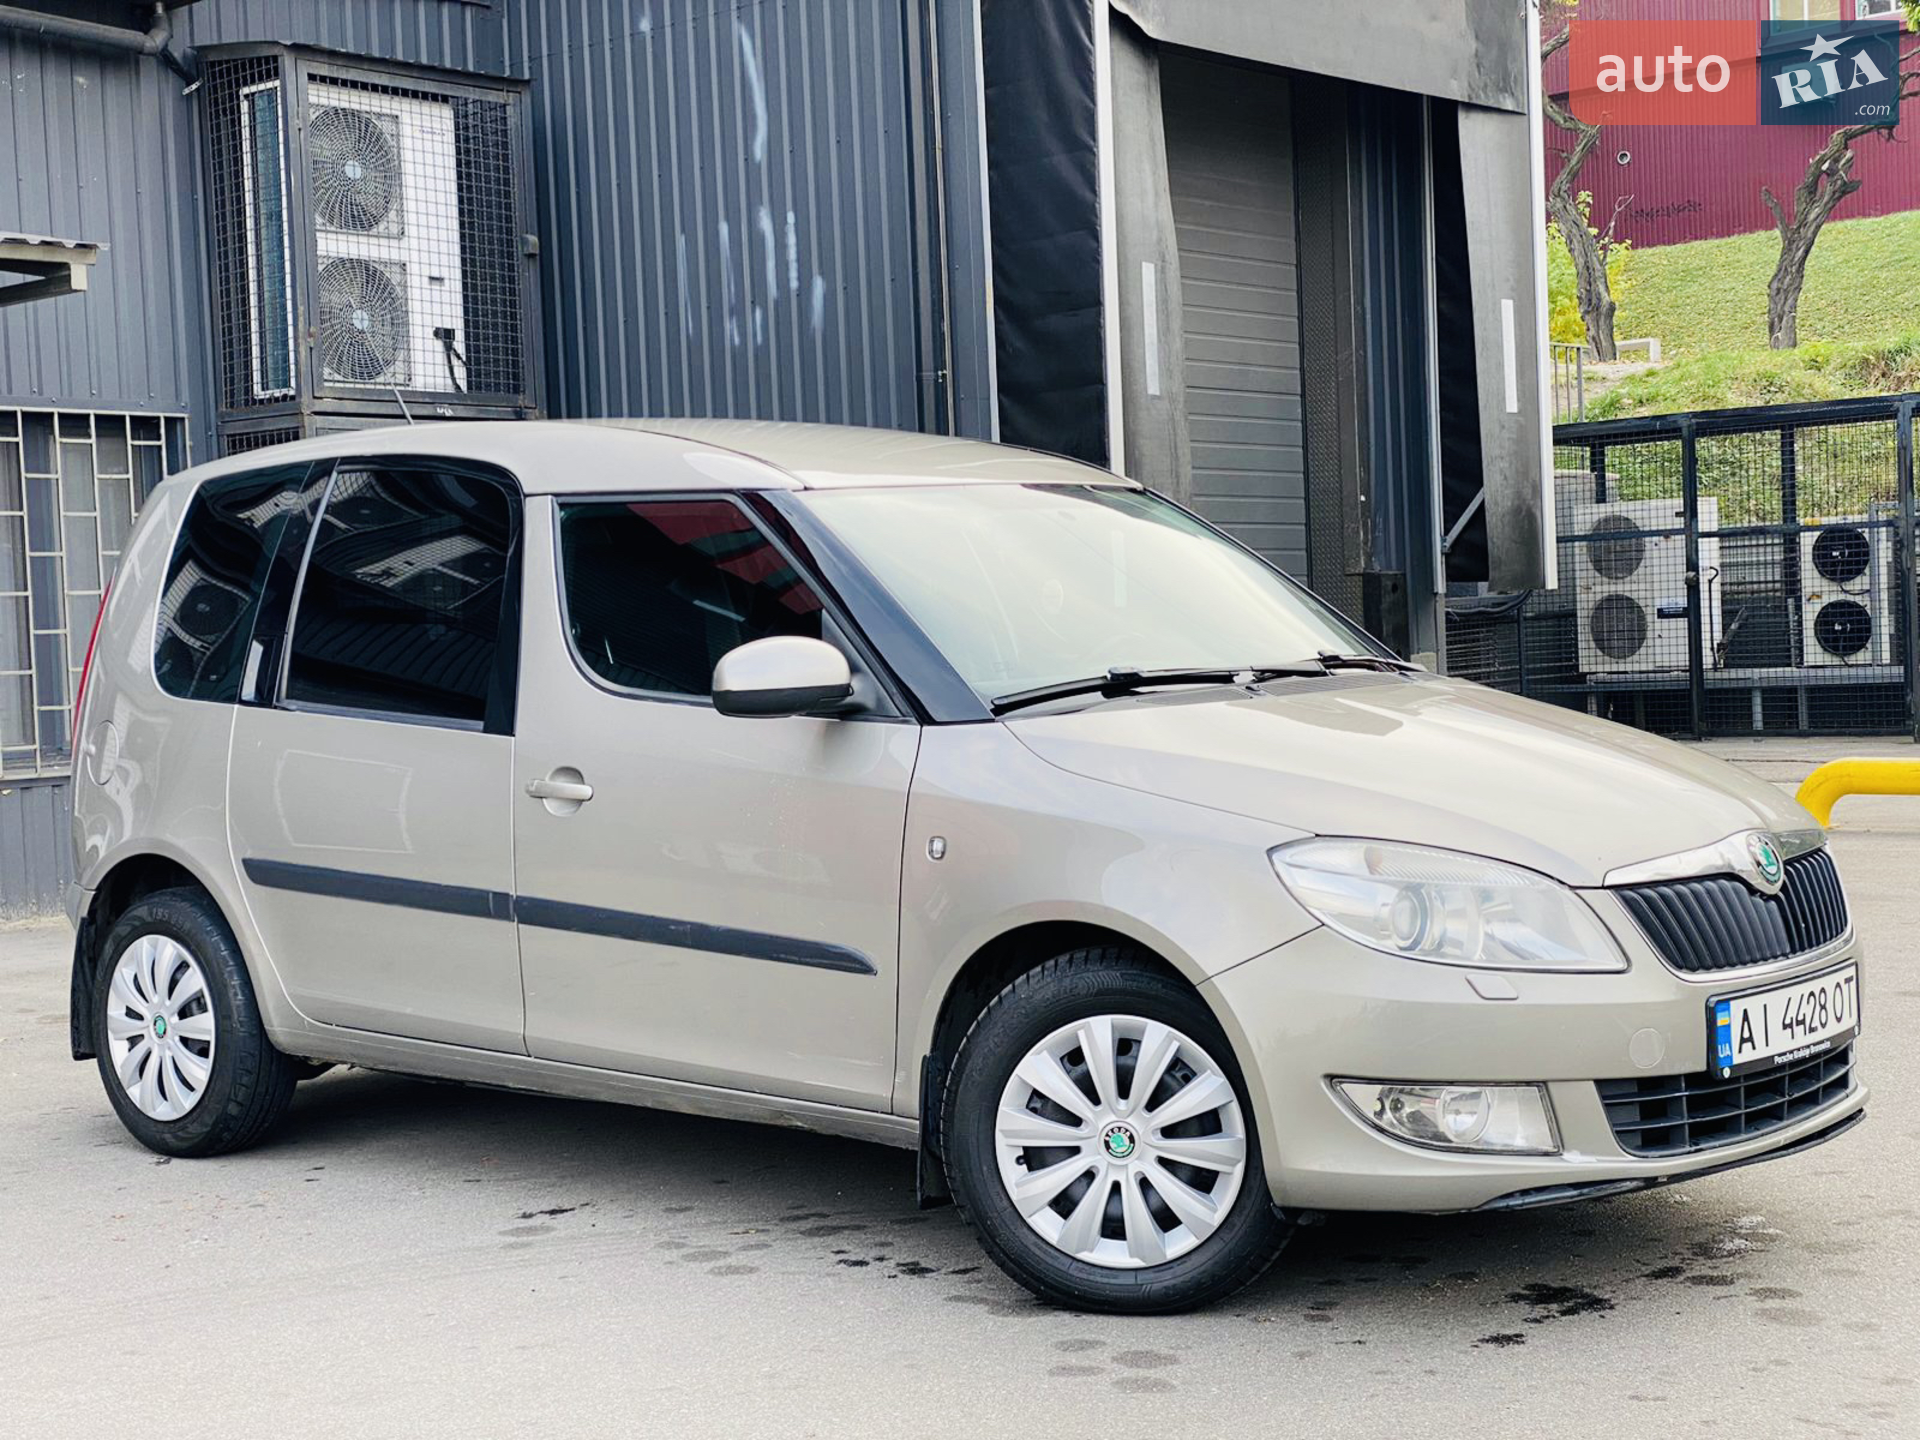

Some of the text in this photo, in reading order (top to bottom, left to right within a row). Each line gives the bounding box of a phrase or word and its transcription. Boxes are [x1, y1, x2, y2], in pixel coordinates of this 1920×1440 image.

[1738, 975, 1854, 1054] AI 4428 OT
[1717, 1043, 1731, 1058] UA
